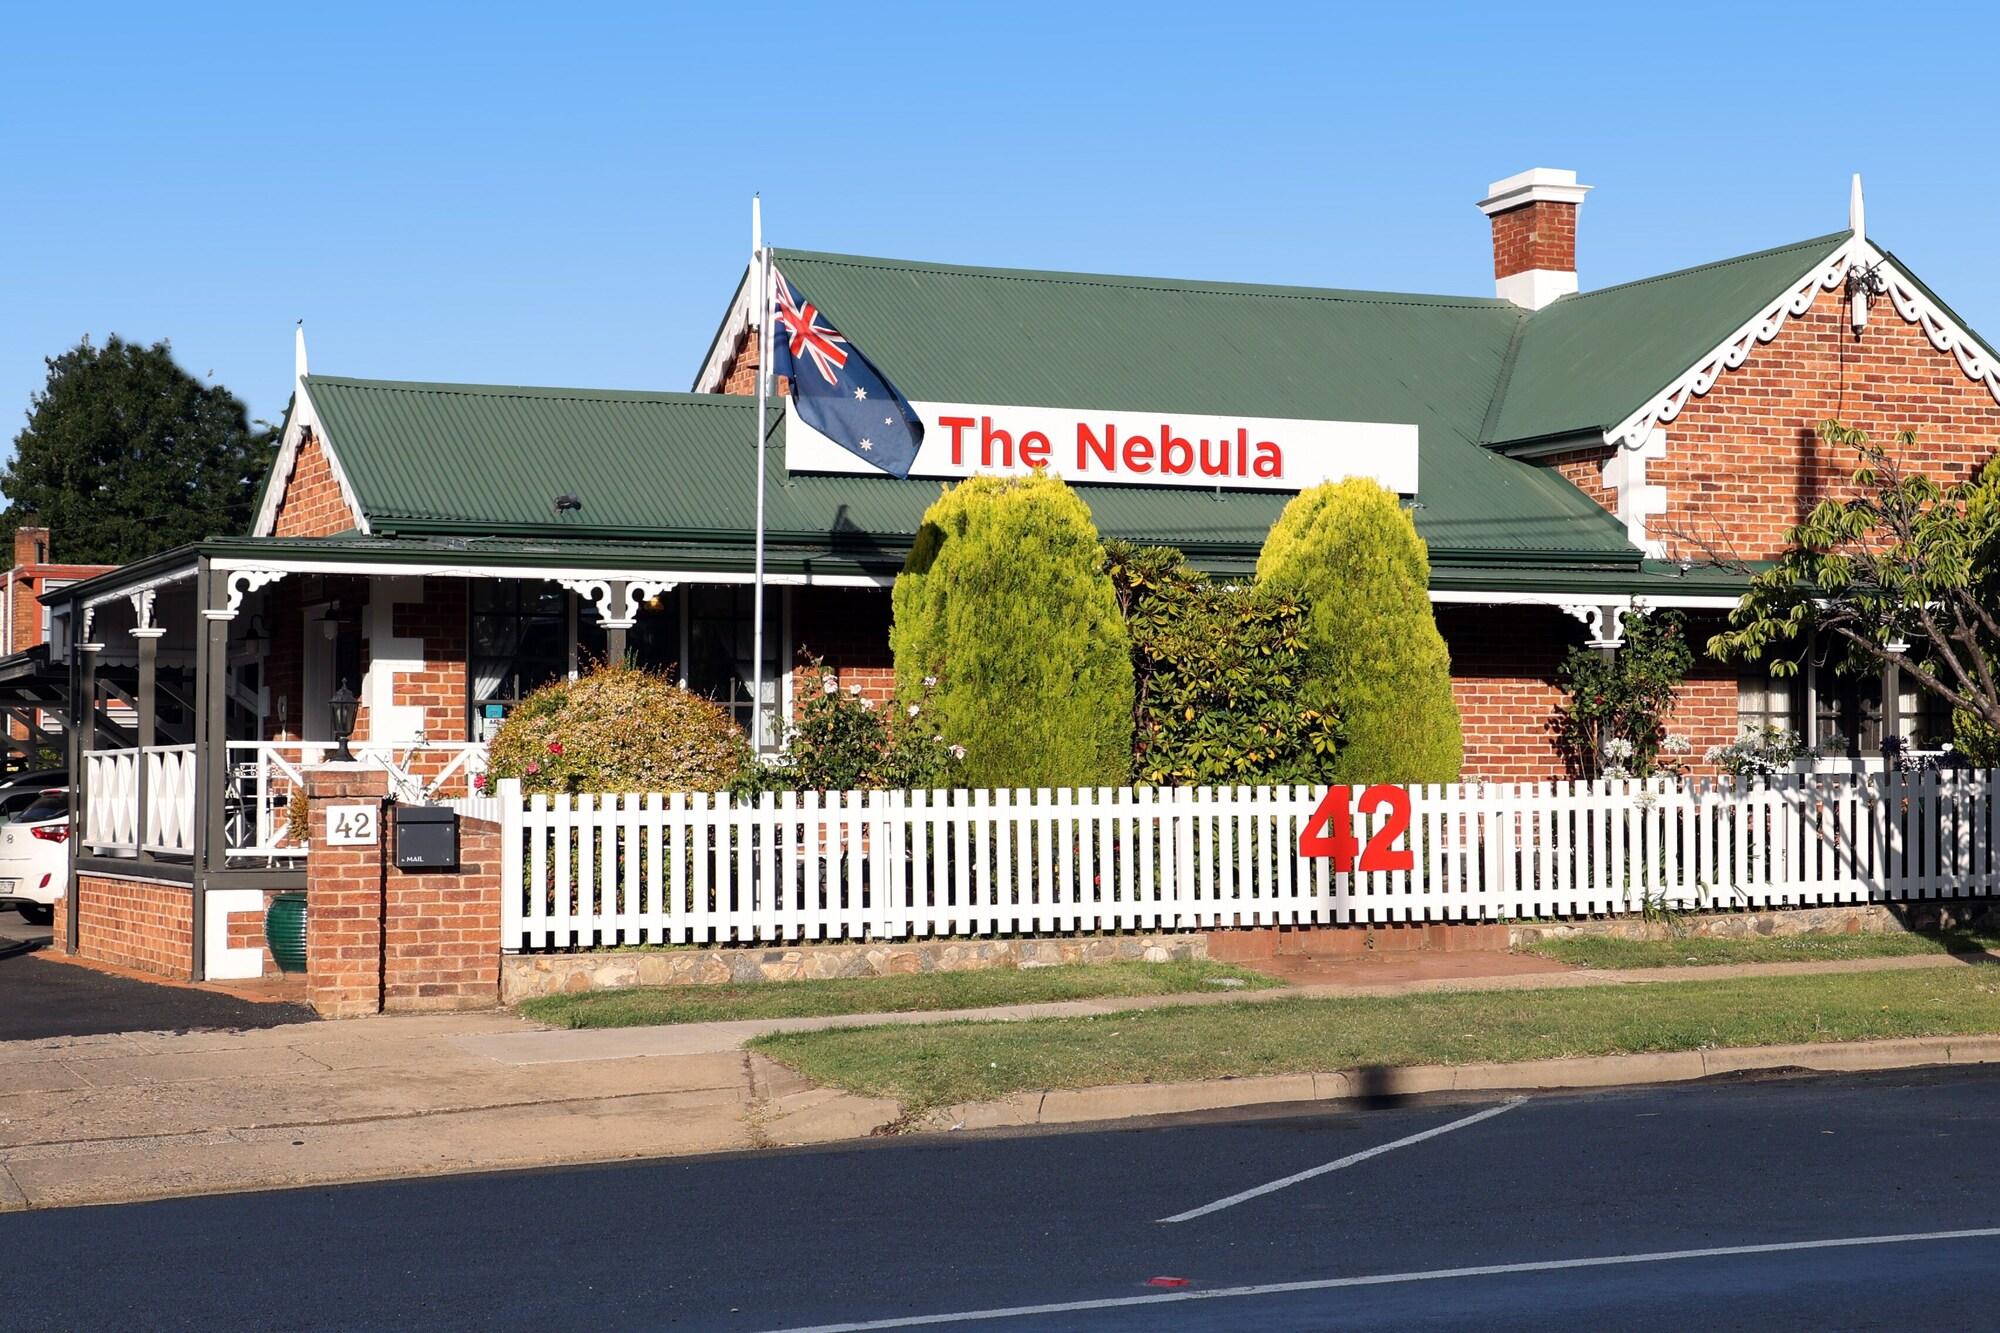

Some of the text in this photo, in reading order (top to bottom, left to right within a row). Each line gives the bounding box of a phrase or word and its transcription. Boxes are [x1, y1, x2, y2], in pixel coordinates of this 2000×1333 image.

[938, 416, 1282, 478] The Nebula
[334, 812, 372, 839] 42
[1299, 784, 1414, 873] 42
[406, 855, 424, 863] MAIL
